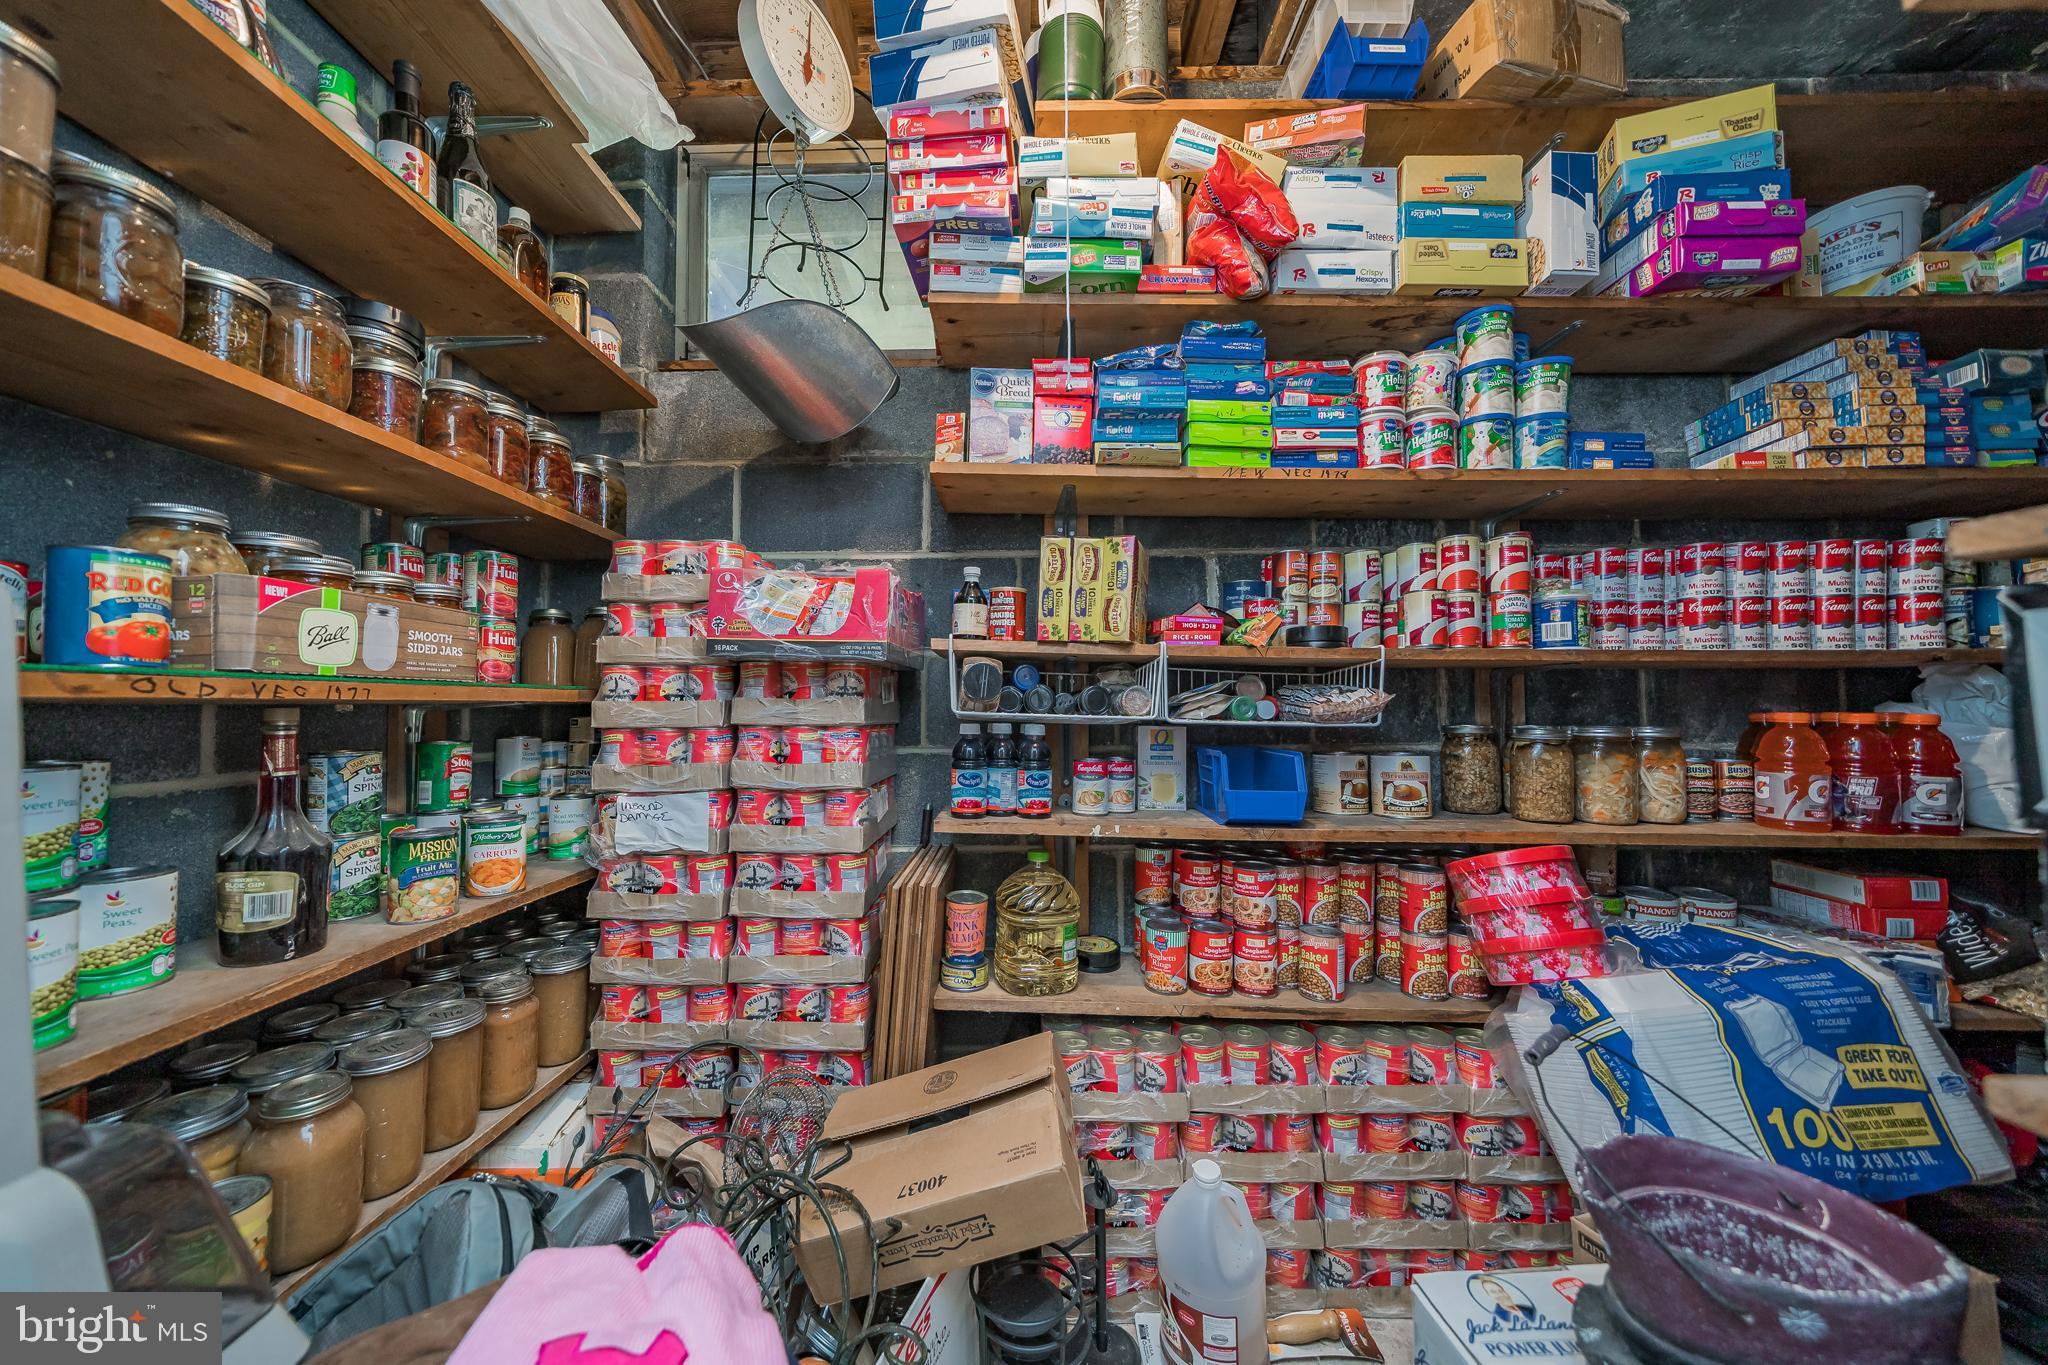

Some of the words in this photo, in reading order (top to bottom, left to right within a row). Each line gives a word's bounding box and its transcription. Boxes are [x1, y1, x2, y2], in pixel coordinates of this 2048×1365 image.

[952, 36, 970, 51] WHEAT
[970, 32, 990, 46] PUFFED
[1725, 113, 1760, 127] Toasted
[1733, 122, 1753, 132] Oats
[1182, 126, 1200, 139] WHOLE
[1200, 132, 1217, 143] GRAIN
[1232, 142, 1263, 161] Cheerios
[1730, 151, 1762, 162] Crisp
[1734, 160, 1760, 169] Rice
[936, 219, 980, 230] FREE
[1110, 221, 1128, 230] GRAIN
[1129, 222, 1147, 231] WHOLE
[1365, 231, 1394, 242] Tasteeos
[1071, 252, 1097, 266] Chex
[1418, 250, 1445, 258] Toasted
[1925, 261, 1950, 272] GLAD
[1360, 269, 1384, 277] Crispy
[1355, 275, 1389, 284] Hexagons
[1484, 318, 1508, 328] Creamy
[1474, 324, 1506, 336] Supreme
[1000, 375, 1031, 387] Quick
[1533, 371, 1560, 381] Creamy
[1286, 377, 1315, 388] Funfetti
[1523, 377, 1556, 390] Supreme
[996, 386, 1031, 397] Bread
[1113, 392, 1142, 402] Funfetti
[1106, 425, 1134, 435] Funfetti
[1411, 428, 1450, 448] Holiday
[1222, 468, 1268, 479] NEW
[86, 572, 144, 592] RED
[188, 583, 206, 597] 12
[264, 584, 289, 598] NEW!
[138, 602, 163, 610] DICED
[468, 616, 478, 626] 12
[990, 619, 1016, 627] POWDER
[307, 624, 351, 650] Ball
[407, 629, 454, 644] SMOOTH
[407, 643, 438, 656] SIDED
[439, 644, 463, 657] JARS
[130, 677, 217, 697] OLD
[250, 682, 309, 700] VEG
[325, 685, 371, 700] 1977
[1849, 784, 1873, 796] PRO
[1915, 783, 1948, 806] G
[619, 812, 673, 823] DAMAGE
[408, 838, 457, 861] MISSION
[473, 848, 519, 859] CARROTS
[420, 851, 452, 862] PRIDE
[415, 865, 436, 874] Fruit
[438, 862, 453, 870] Mix
[612, 862, 632, 877] Walk
[643, 864, 662, 879] About
[756, 862, 775, 874] About
[1145, 869, 1171, 878] Spaghetti
[1151, 876, 1168, 884] Rings
[1189, 874, 1215, 882] Spaghetti
[247, 881, 265, 889] GIN
[1235, 881, 1260, 891] Spaghetti
[102, 907, 143, 919] Sweet
[952, 920, 978, 932] PINK
[832, 927, 849, 942] About
[1204, 946, 1230, 955] Spaghetti
[1242, 946, 1270, 955] Spaghetti
[1147, 952, 1177, 963] Spaghetti
[1300, 950, 1328, 964] Baked
[1152, 960, 1172, 970] Rings
[1417, 960, 1445, 972] Beans
[953, 978, 973, 987] CLAMS
[1784, 981, 1834, 991] CONSTRUCTION
[746, 994, 765, 1008] Walk
[800, 992, 820, 1008] Walk
[1816, 1017, 1851, 1027] STACKABLE
[1335, 1056, 1355, 1068] Walk
[1412, 1050, 1433, 1068] About
[1845, 1049, 1884, 1064] GREAT
[1887, 1047, 1914, 1065] FOR
[834, 1059, 851, 1077] About
[1067, 1062, 1083, 1077] Walk
[1146, 1061, 1166, 1079] About
[1853, 1068, 1887, 1083] TAKE
[1889, 1069, 1921, 1084] OUT!
[1235, 1118, 1255, 1135] About
[1767, 1107, 1854, 1151] 100
[1873, 1120, 1883, 1130] LID
[1883, 1118, 1928, 1130] CONTAINERS
[1468, 1126, 1489, 1139] Walk
[897, 1174, 948, 1199] 40037
[909, 1230, 958, 1251] Mountain
[887, 1245, 908, 1256] Iron
[1466, 1318, 1501, 1344] Jack
[1508, 1315, 1532, 1331] La
[1485, 1342, 1546, 1357] POWER
